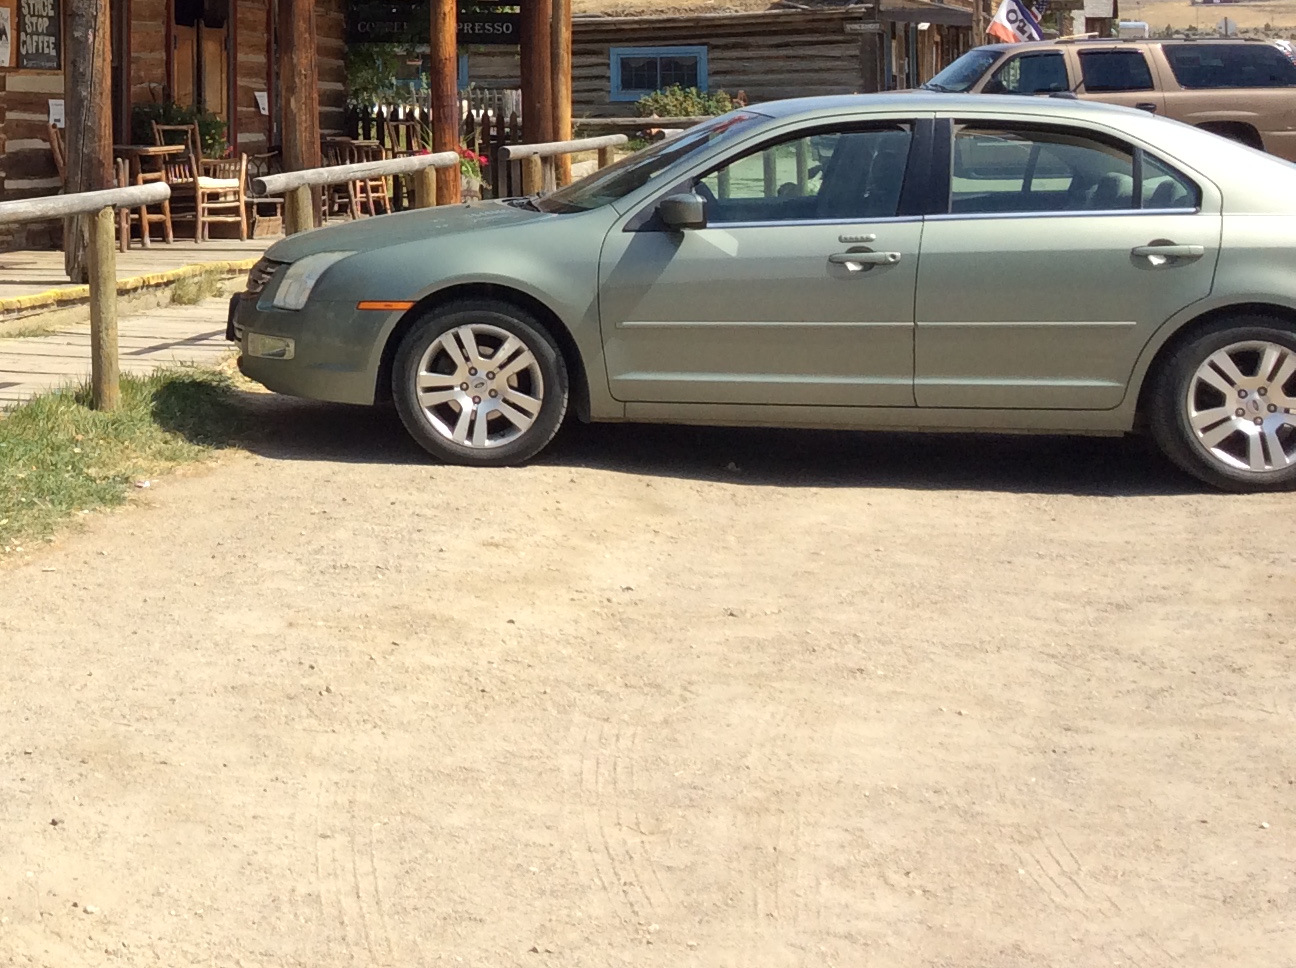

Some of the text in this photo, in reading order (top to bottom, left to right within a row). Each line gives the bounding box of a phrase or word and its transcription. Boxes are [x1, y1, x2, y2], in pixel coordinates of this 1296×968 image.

[25, 14, 50, 33] STOP
[357, 20, 513, 34] COFE PRESSO
[19, 32, 56, 56] COFFEE
